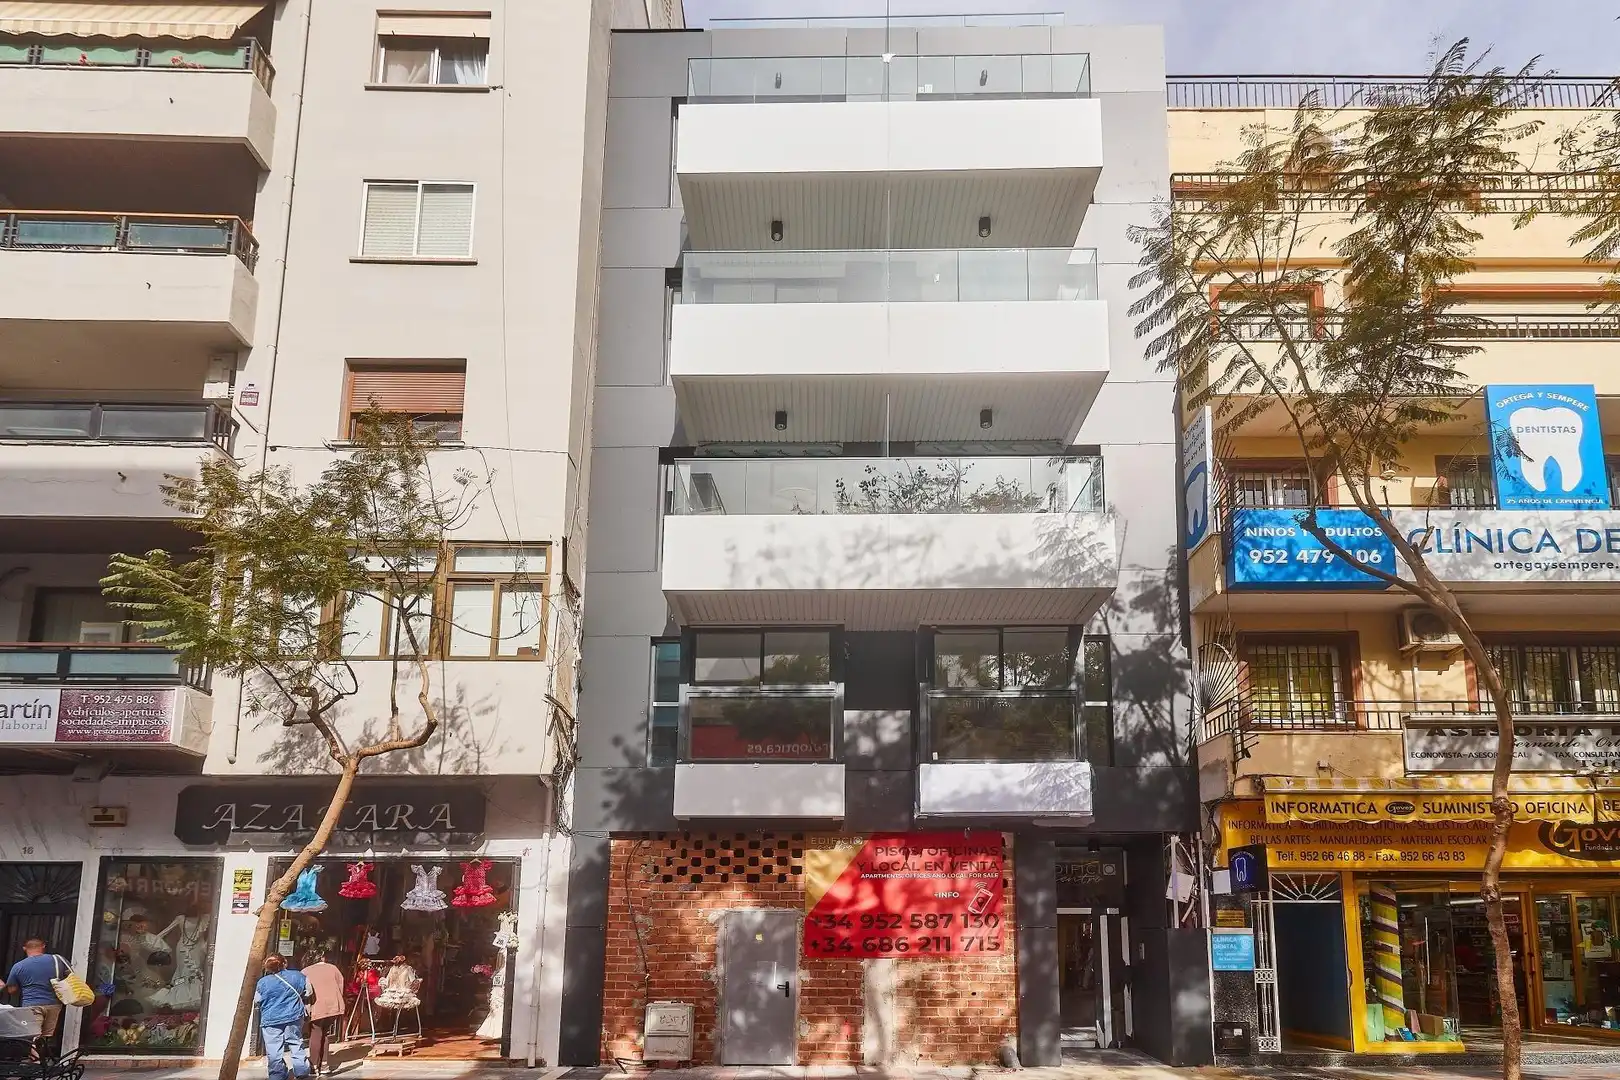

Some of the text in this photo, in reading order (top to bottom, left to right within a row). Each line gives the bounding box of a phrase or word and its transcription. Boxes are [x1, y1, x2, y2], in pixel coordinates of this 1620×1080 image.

[1496, 392, 1534, 408] ORTEGA
[1547, 392, 1590, 412] SEMPERE
[1516, 425, 1577, 434] DENTISTAS
[1325, 527, 1383, 537] DULTOS
[1406, 521, 1562, 555] CLÍNICA
[1249, 549, 1382, 564] 952 479 06
[81, 694, 155, 704] T: 952 475 886
[1, 719, 48, 730] laboral
[1271, 801, 1378, 815] INFORMATICA
[1423, 801, 1519, 814] SUMINISTO
[1526, 801, 1589, 814] OFICINA
[1250, 835, 1488, 845] BELLAS ARTES MANUALIDADES MATERIAL ESCOLAR
[875, 846, 998, 857] PISOS, OFICINAS
[1276, 850, 1466, 862] Telf. 952 66 46 88 Fax. 952 66 43 83
[857, 861, 1000, 872] Y LOCAL EN VENTA
[934, 891, 960, 899] +INFO
[812, 912, 1000, 930] +34 952 587 130
[810, 935, 1001, 953] +34 686 211 715
